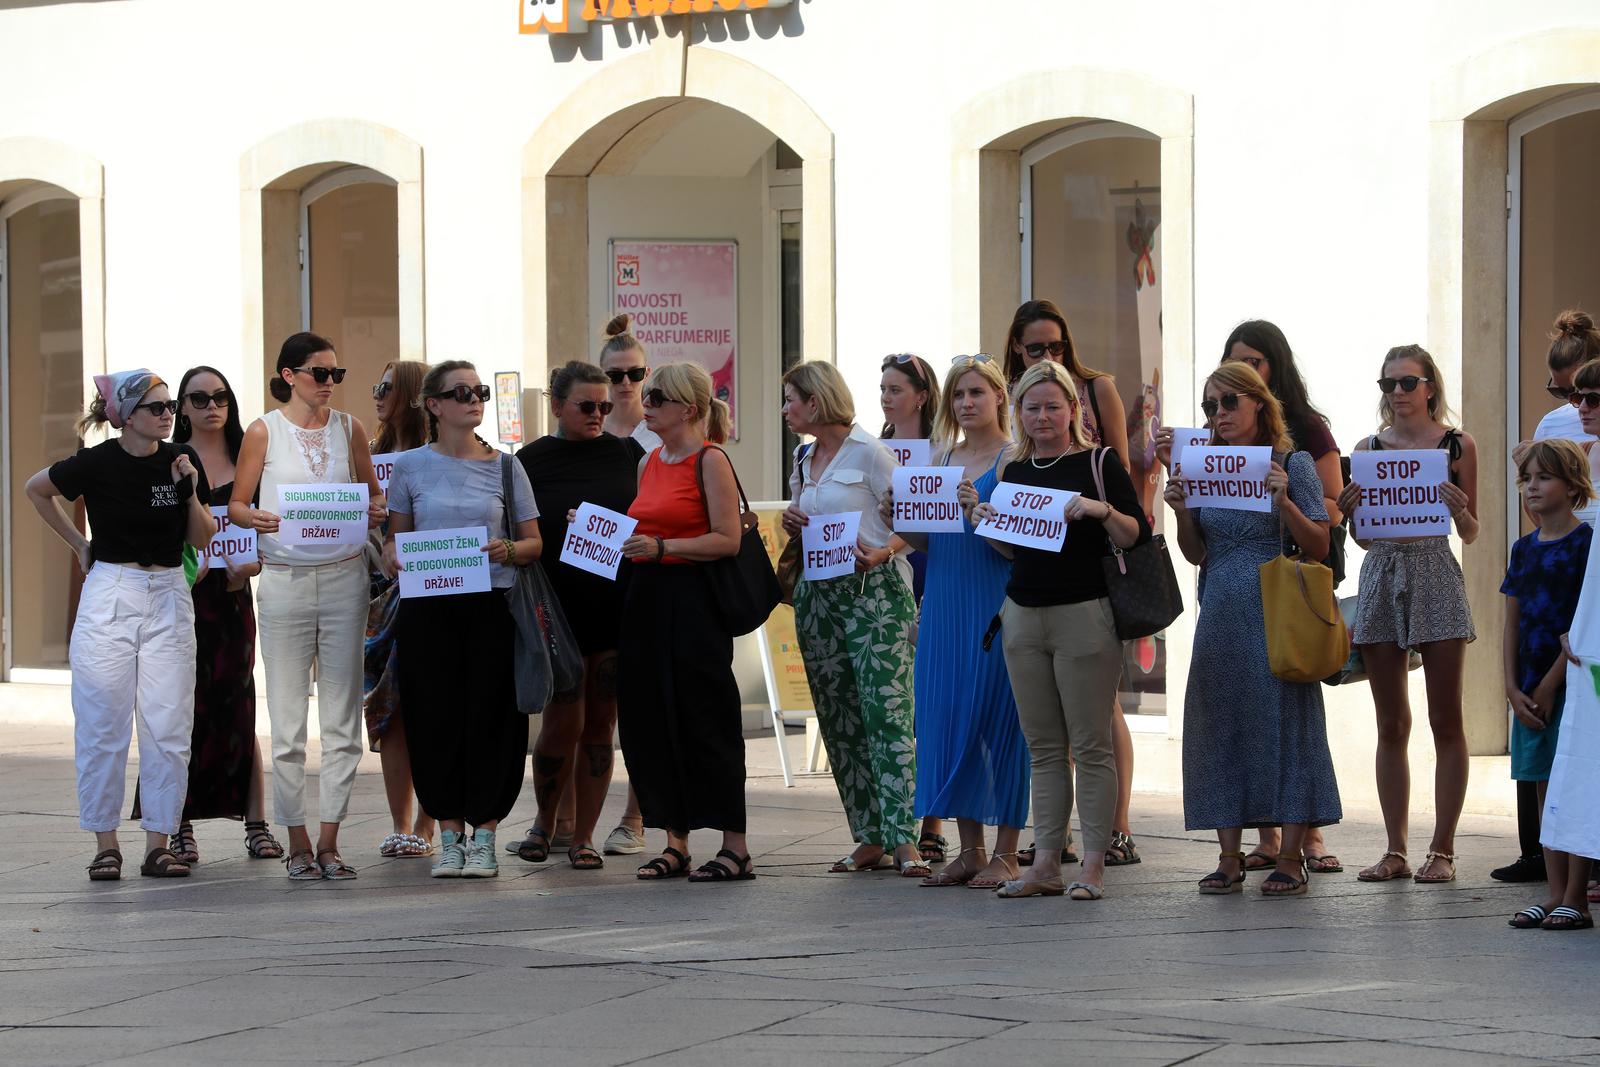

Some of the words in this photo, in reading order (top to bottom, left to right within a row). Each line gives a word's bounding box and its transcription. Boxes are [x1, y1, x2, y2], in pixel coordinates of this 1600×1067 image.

[617, 293, 682, 308] NOVOSTI
[636, 329, 731, 346] PARFUMERIJE
[893, 448, 911, 466] OP
[1204, 454, 1247, 474] STOP
[374, 462, 394, 481] OP
[1376, 460, 1421, 480] STOP
[909, 475, 943, 494] STOP
[1187, 480, 1267, 500] FEMICIDU!
[284, 491, 336, 502] SIGURNOST
[337, 489, 361, 502] ŽENA
[1011, 491, 1053, 511] STOP
[283, 510, 295, 521] JE
[296, 510, 364, 521] ODGOVORNOST
[896, 502, 959, 521] FEMICIDU!
[301, 525, 341, 539] DRŽAVE!
[586, 514, 618, 539] STOP
[823, 522, 846, 542] STOP
[402, 539, 455, 554] SIGURNOST
[456, 535, 480, 549] ŽENA
[566, 533, 620, 568] FEMICIDU!
[403, 561, 414, 573] JE
[416, 556, 484, 571] ODGOVORNOST
[424, 575, 464, 590] DRŽAVE!
